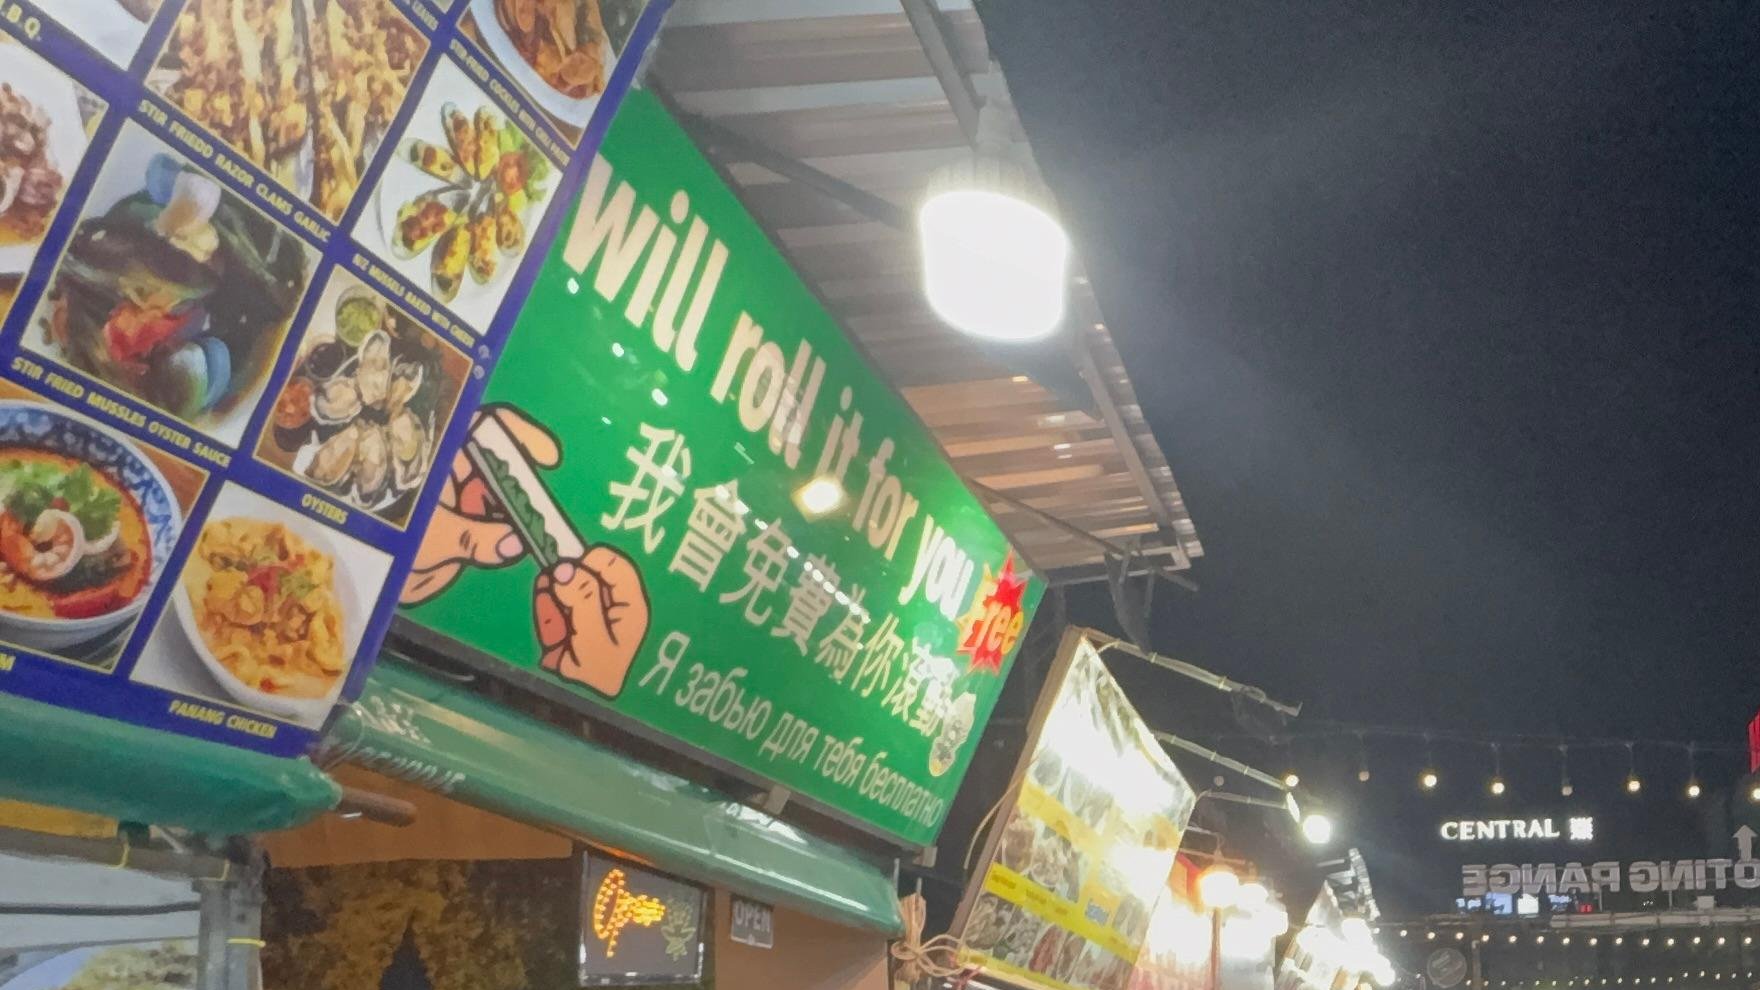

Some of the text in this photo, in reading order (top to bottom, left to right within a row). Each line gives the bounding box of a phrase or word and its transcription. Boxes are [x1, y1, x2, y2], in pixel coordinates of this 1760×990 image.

[139, 99, 168, 127] STIR
[215, 153, 255, 188] RAZOR
[294, 211, 331, 243] GARLIC
[11, 356, 44, 380] STIR
[45, 372, 84, 398] FRIED
[149, 421, 192, 449] OYSTER
[193, 442, 233, 470] SAUCE
[562, 151, 974, 621] will roll it for you
[302, 493, 348, 524] OYSTERS
[226, 713, 278, 740] CHICKEN
[638, 631, 945, 829] Я забью для тебя бесплатно
[1440, 818, 1560, 840] CENTRAL
[733, 900, 772, 934] OPEN
